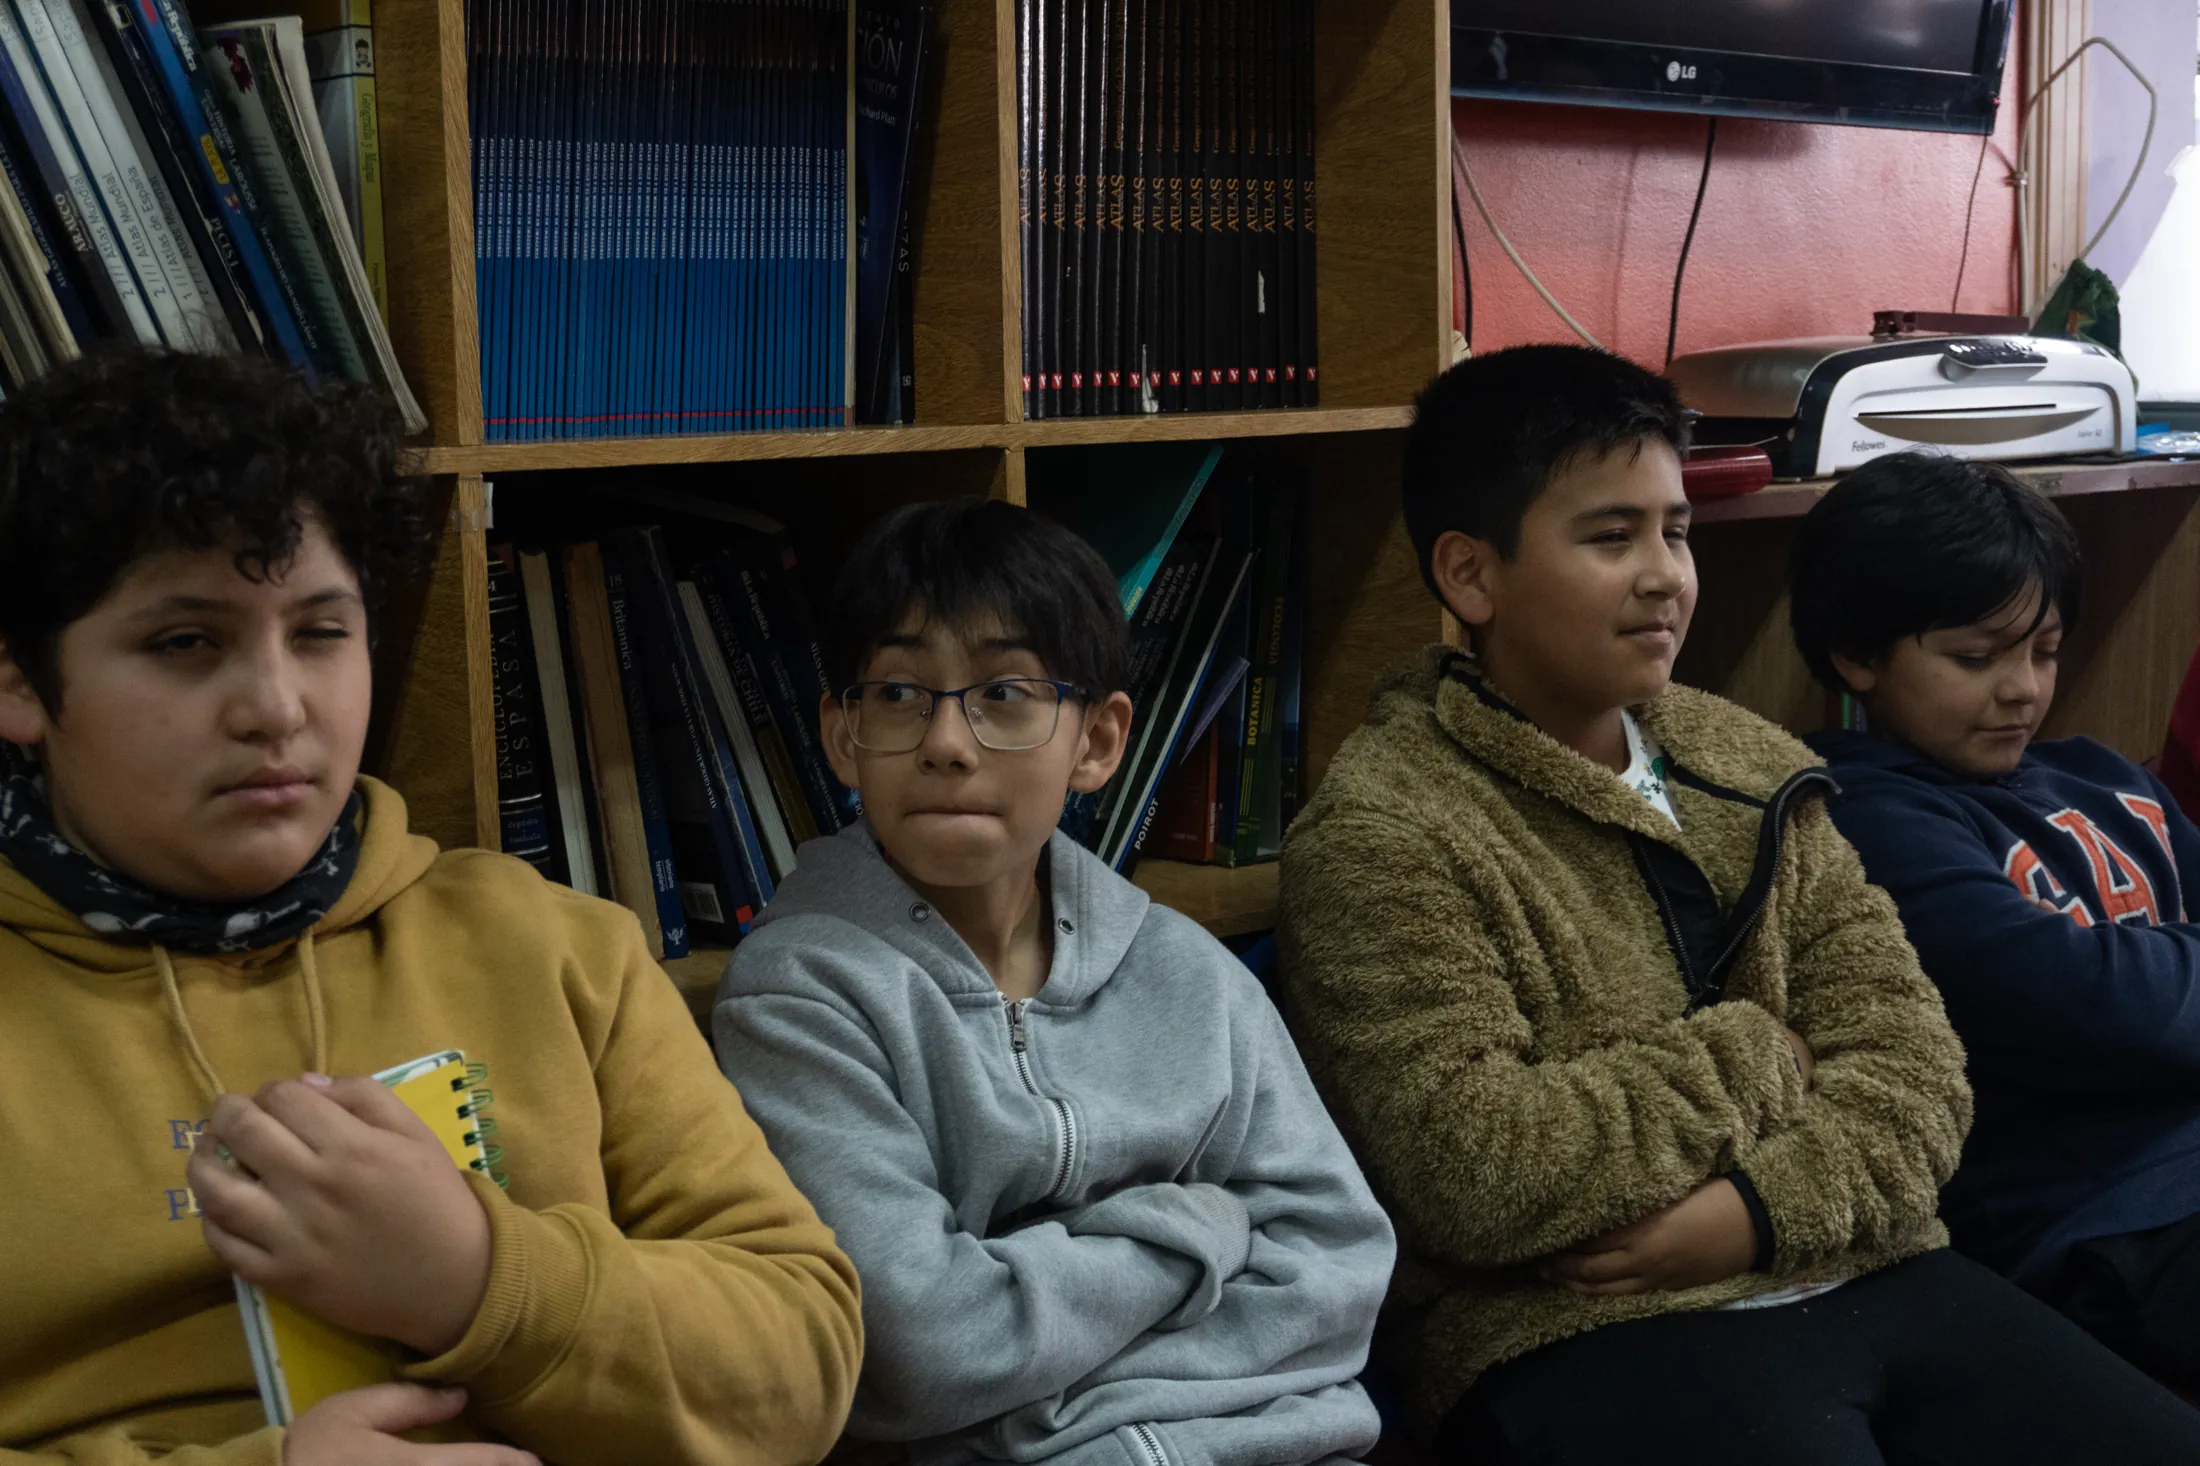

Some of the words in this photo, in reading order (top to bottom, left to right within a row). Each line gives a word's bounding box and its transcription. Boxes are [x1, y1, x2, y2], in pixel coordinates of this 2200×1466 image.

[167, 10, 197, 72] República
[1681, 65, 1697, 80] LG
[69, 172, 100, 224] Mundial
[102, 172, 130, 223] Mundial
[128, 166, 150, 211] España
[230, 157, 258, 211] LAROUSSE
[1020, 168, 1031, 228] ATLAS
[1054, 174, 1066, 232] ATLAS
[1074, 175, 1087, 232] ATLAS
[1096, 175, 1107, 231] ATLAS
[1110, 175, 1125, 231] ATLAS
[1132, 177, 1145, 234] ATLAS
[1152, 178, 1165, 233] ATLAS
[1170, 178, 1182, 233] ATLAS
[1190, 178, 1203, 232] ATLAS
[1210, 178, 1222, 233] ATLAS
[1226, 178, 1240, 232] ATLAS
[1247, 179, 1258, 232] ATLAS
[1264, 180, 1276, 235] ATLAS
[1284, 178, 1295, 232] ATLAS
[1304, 180, 1314, 233] ATLAS
[55, 193, 90, 252] ARAUCO
[97, 227, 118, 259] Atlas
[129, 227, 149, 259] Atlas
[149, 213, 162, 230] de
[160, 233, 179, 266] Atlas
[1852, 440, 1886, 452] Fellowes
[608, 574, 623, 587] 18
[612, 599, 633, 670] Britannica
[810, 641, 824, 669] ATLAS
[500, 629, 533, 779] ESPASA
[1134, 797, 1160, 850] POIROT
